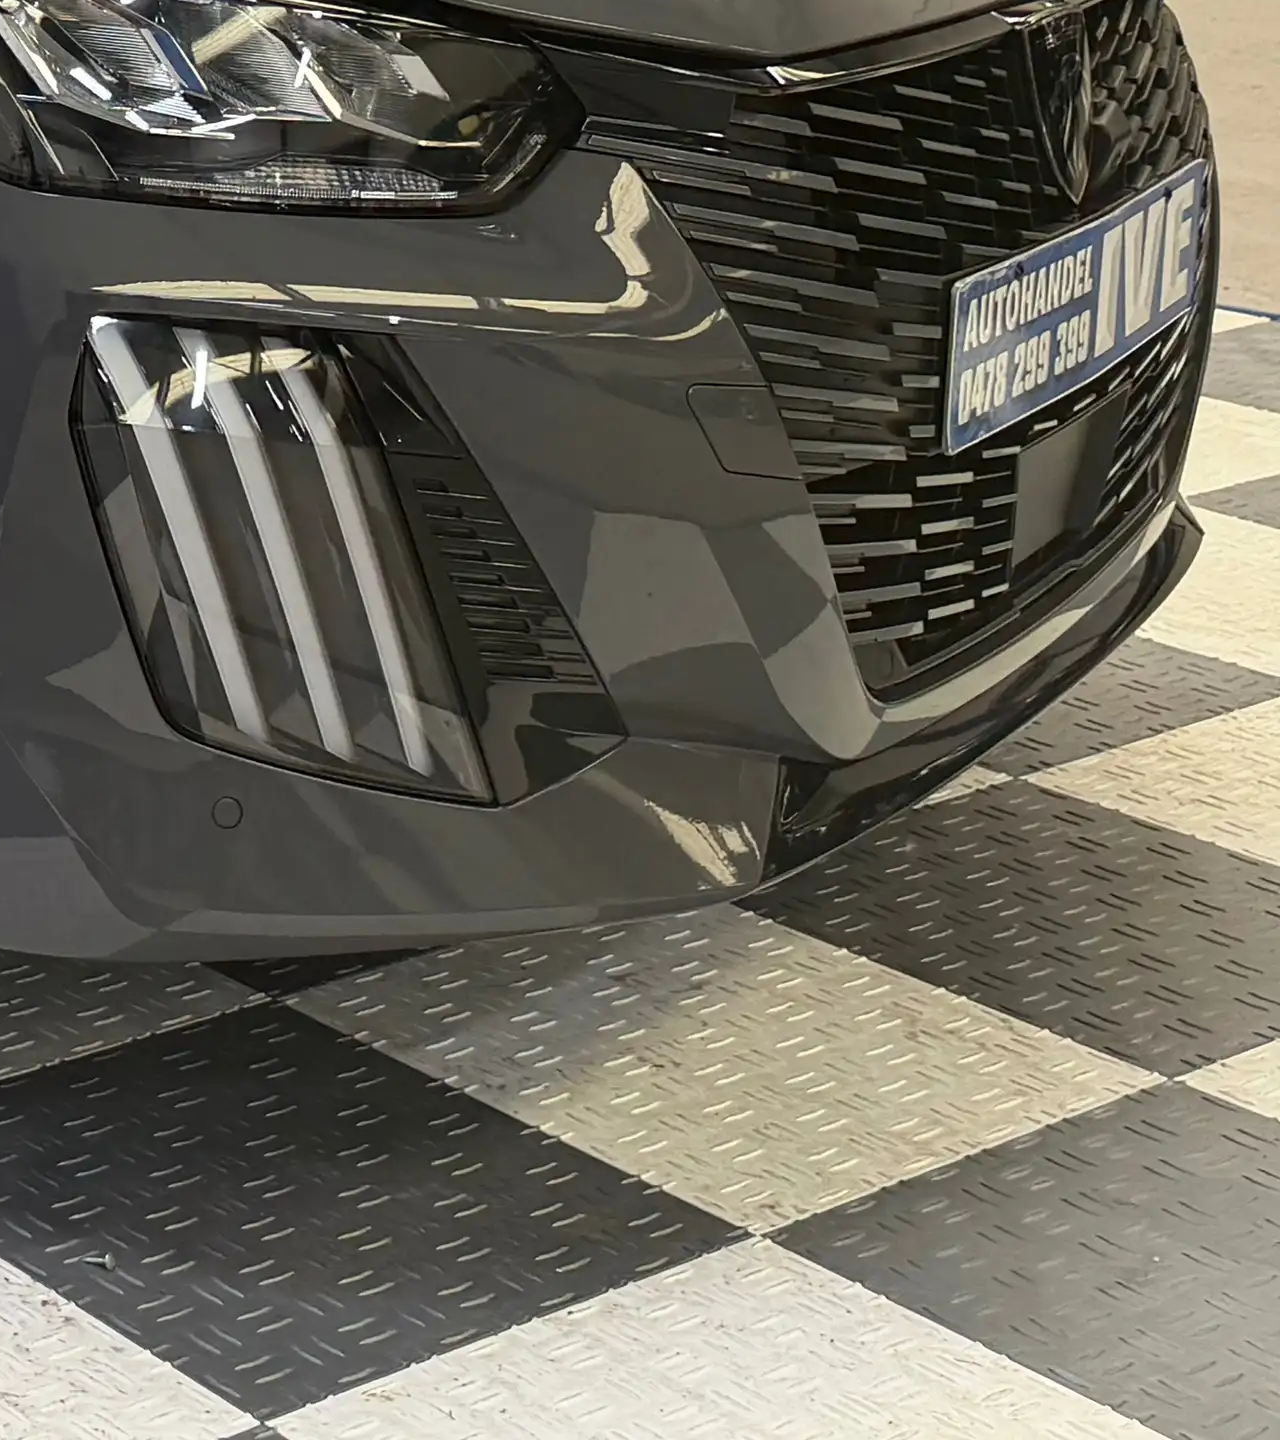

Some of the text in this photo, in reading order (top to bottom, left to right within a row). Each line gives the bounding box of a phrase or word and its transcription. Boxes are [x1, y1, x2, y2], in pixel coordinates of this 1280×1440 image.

[963, 245, 1094, 353] AUTOHANDEL
[1094, 178, 1195, 359] IVE
[957, 309, 1092, 426] 0478 299 399
